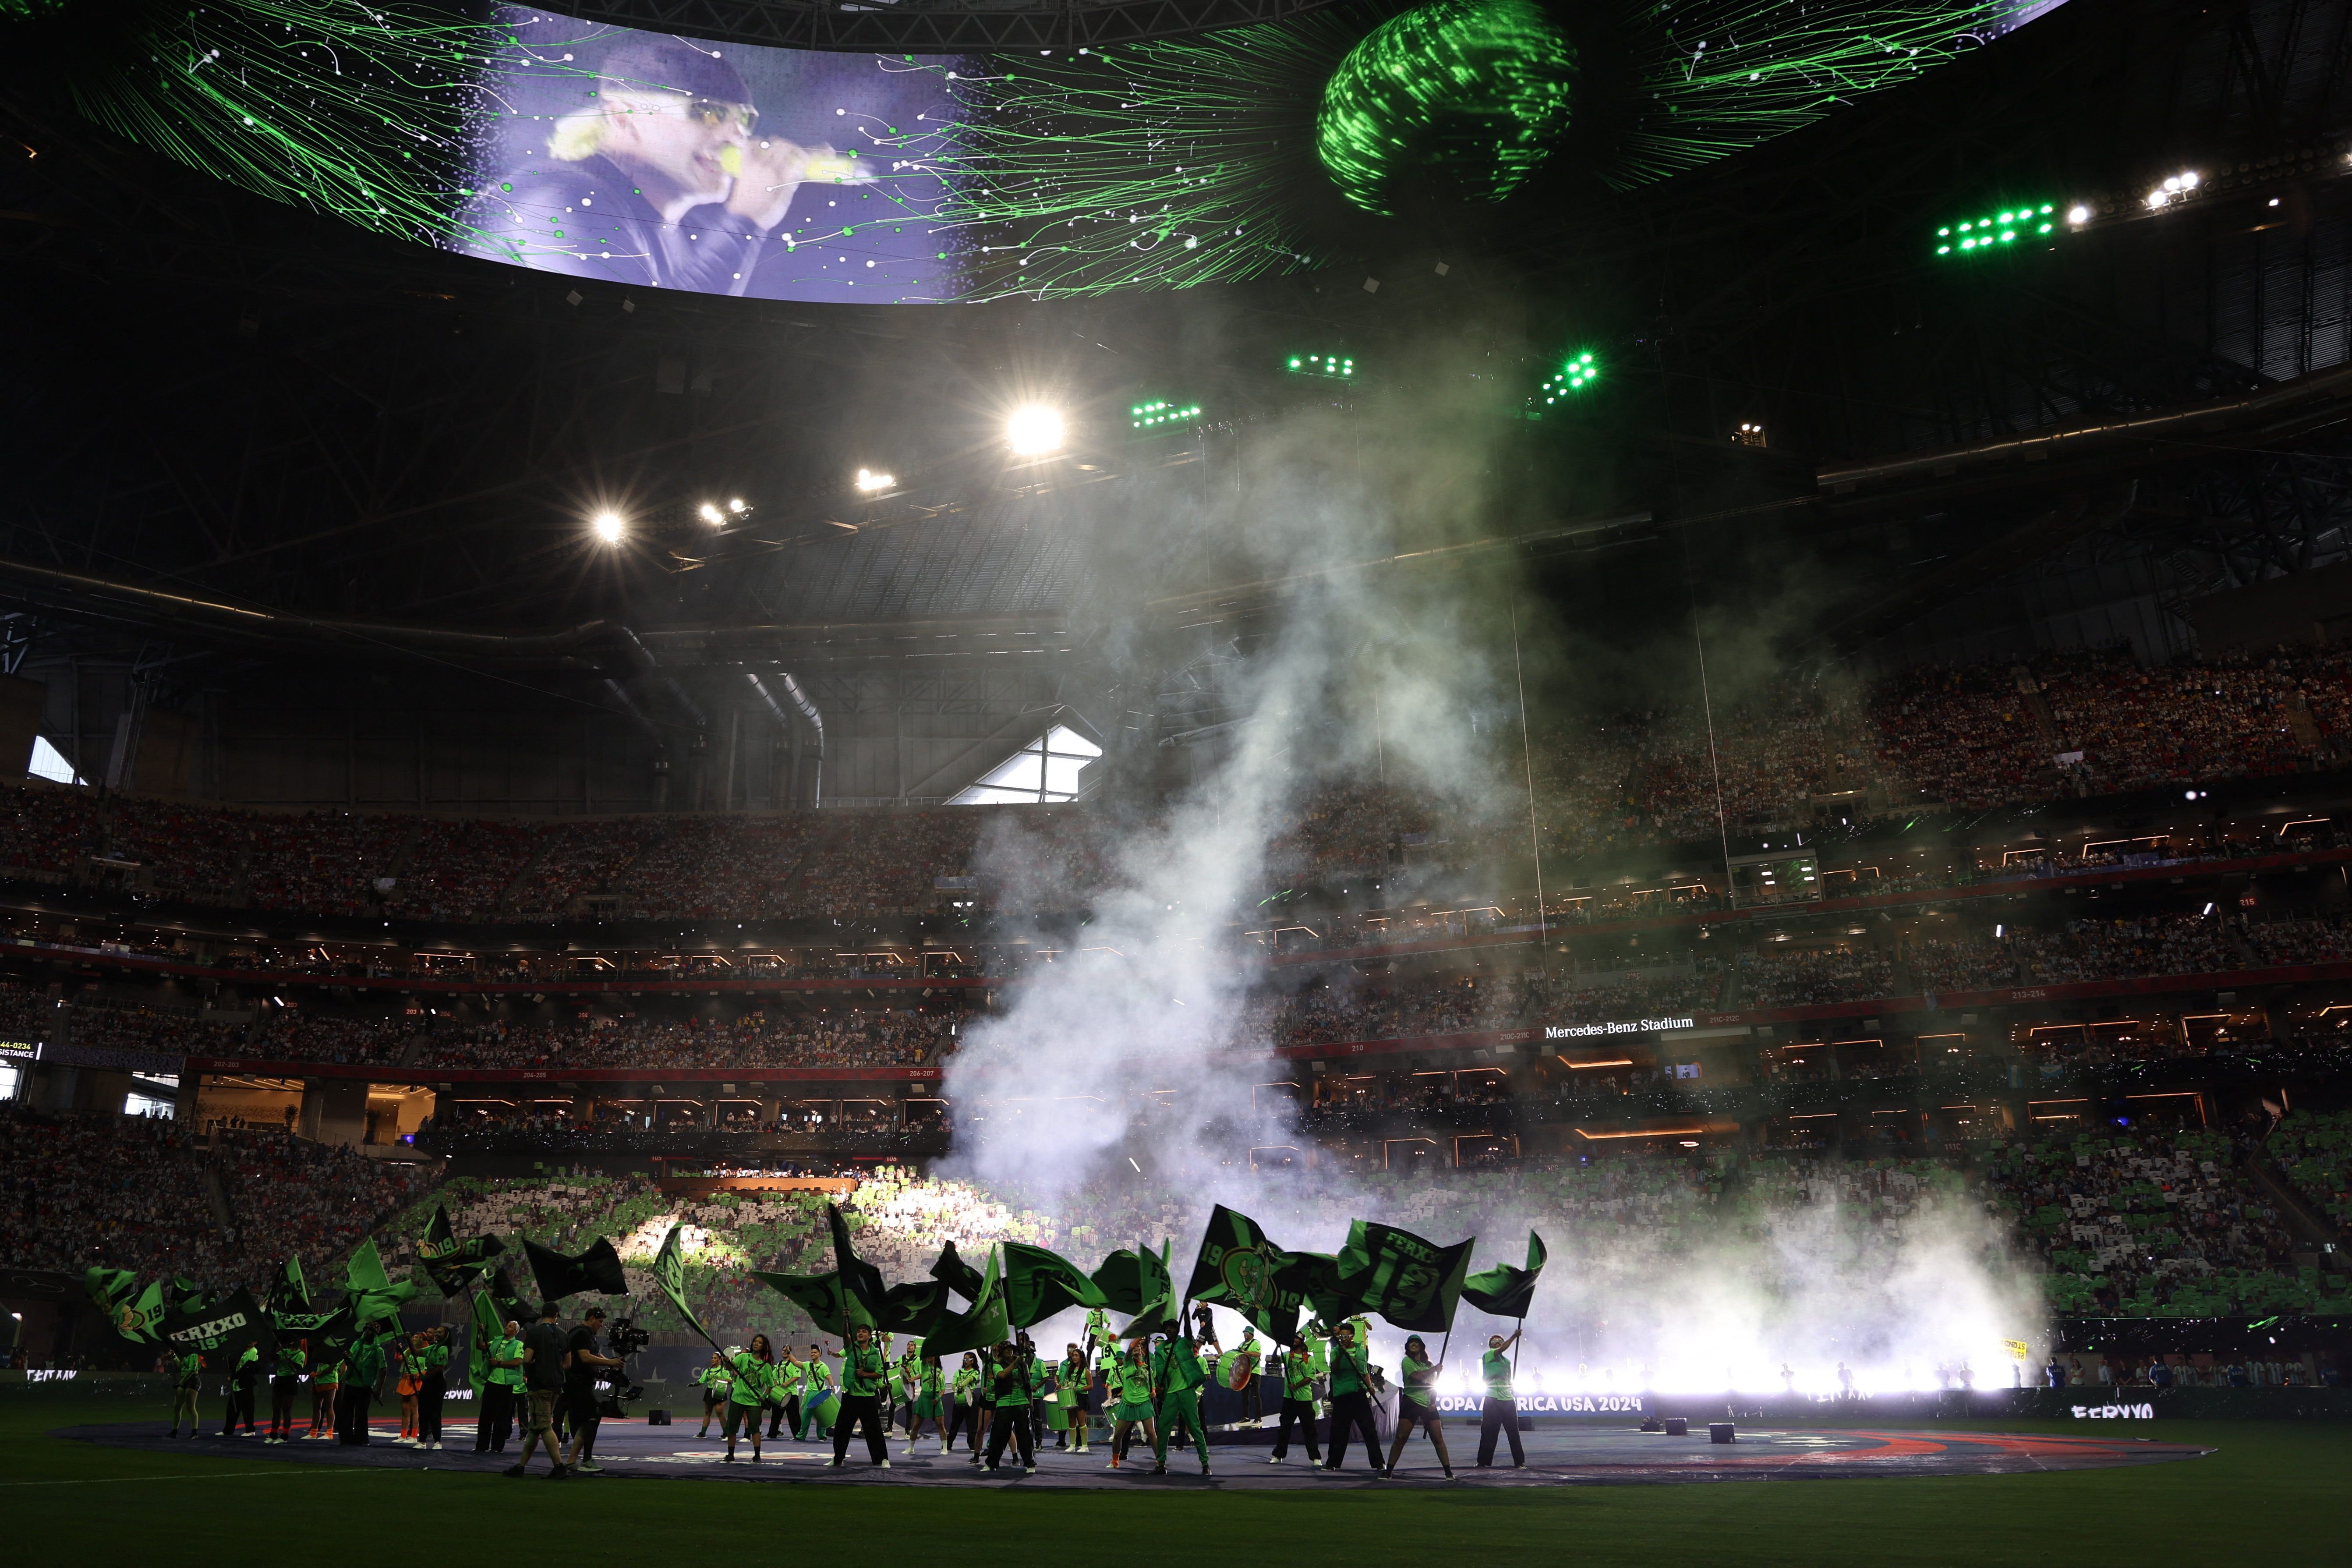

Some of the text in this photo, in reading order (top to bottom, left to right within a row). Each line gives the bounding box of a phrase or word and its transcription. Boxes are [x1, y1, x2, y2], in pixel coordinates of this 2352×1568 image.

[2012, 990, 2046, 999] 213-214
[1710, 1015, 1740, 1023] 211C-212C
[1545, 1017, 1694, 1039] Mercedes-Benz Stadium
[1500, 1032, 1530, 1041] 210C-211C
[0, 1041, 31, 1050] 44-0234
[1201, 1241, 1224, 1267] 19
[1361, 1246, 1441, 1321] 19
[147, 1303, 163, 1322] 19
[198, 1337, 219, 1351] 19
[1101, 1345, 1112, 1358] 19
[1436, 1396, 1642, 1412] COPA RICA USA 2024
